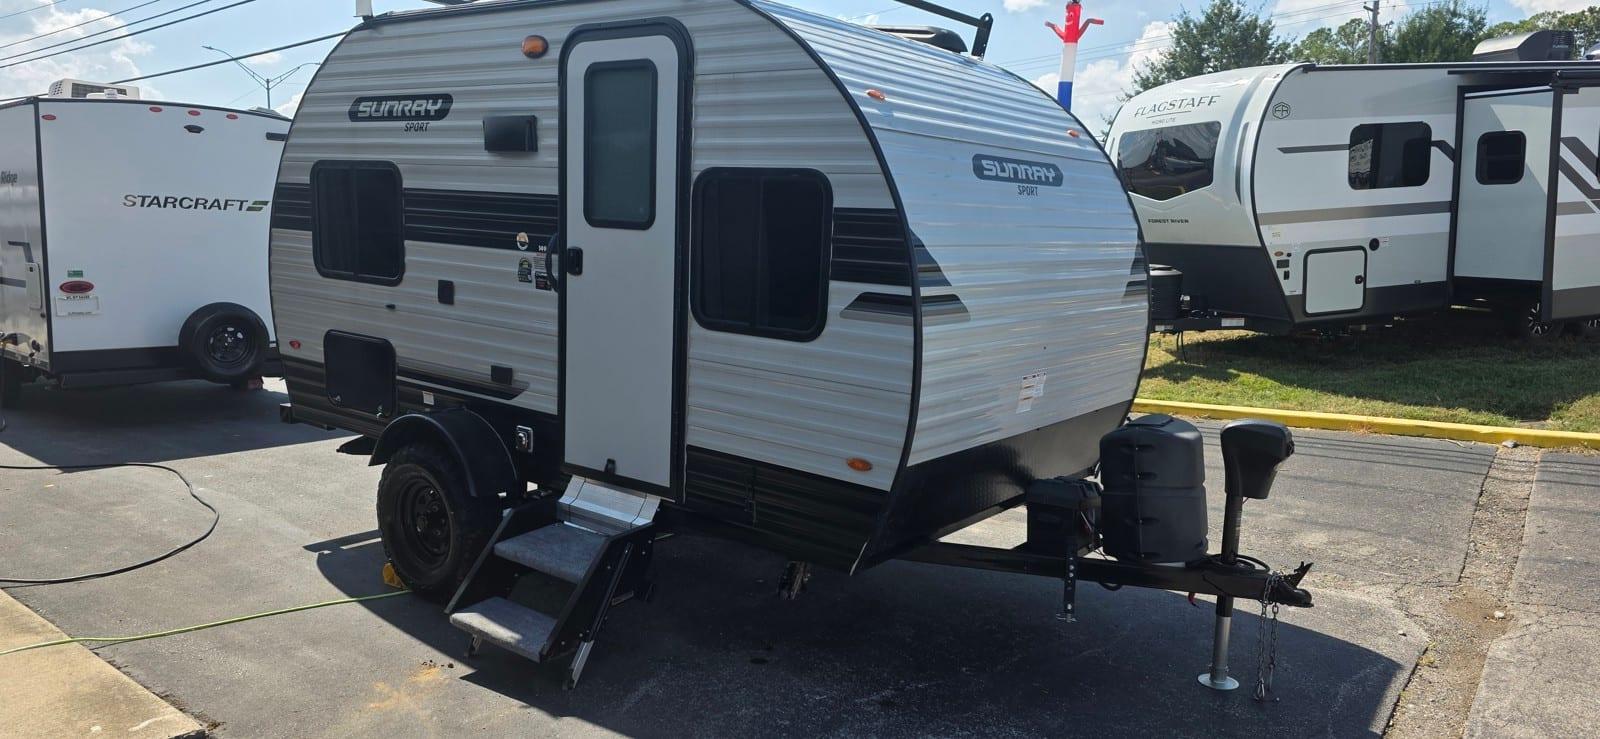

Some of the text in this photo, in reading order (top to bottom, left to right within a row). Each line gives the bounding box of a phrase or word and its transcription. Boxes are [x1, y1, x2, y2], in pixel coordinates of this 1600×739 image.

[357, 99, 443, 117] SUNRAY
[1134, 95, 1221, 118] FLAGSTAFF
[404, 121, 430, 132] SPORT
[981, 159, 1056, 182] SUNRAY
[1017, 185, 1039, 196] SPORT
[122, 194, 249, 212] STARCRAFT
